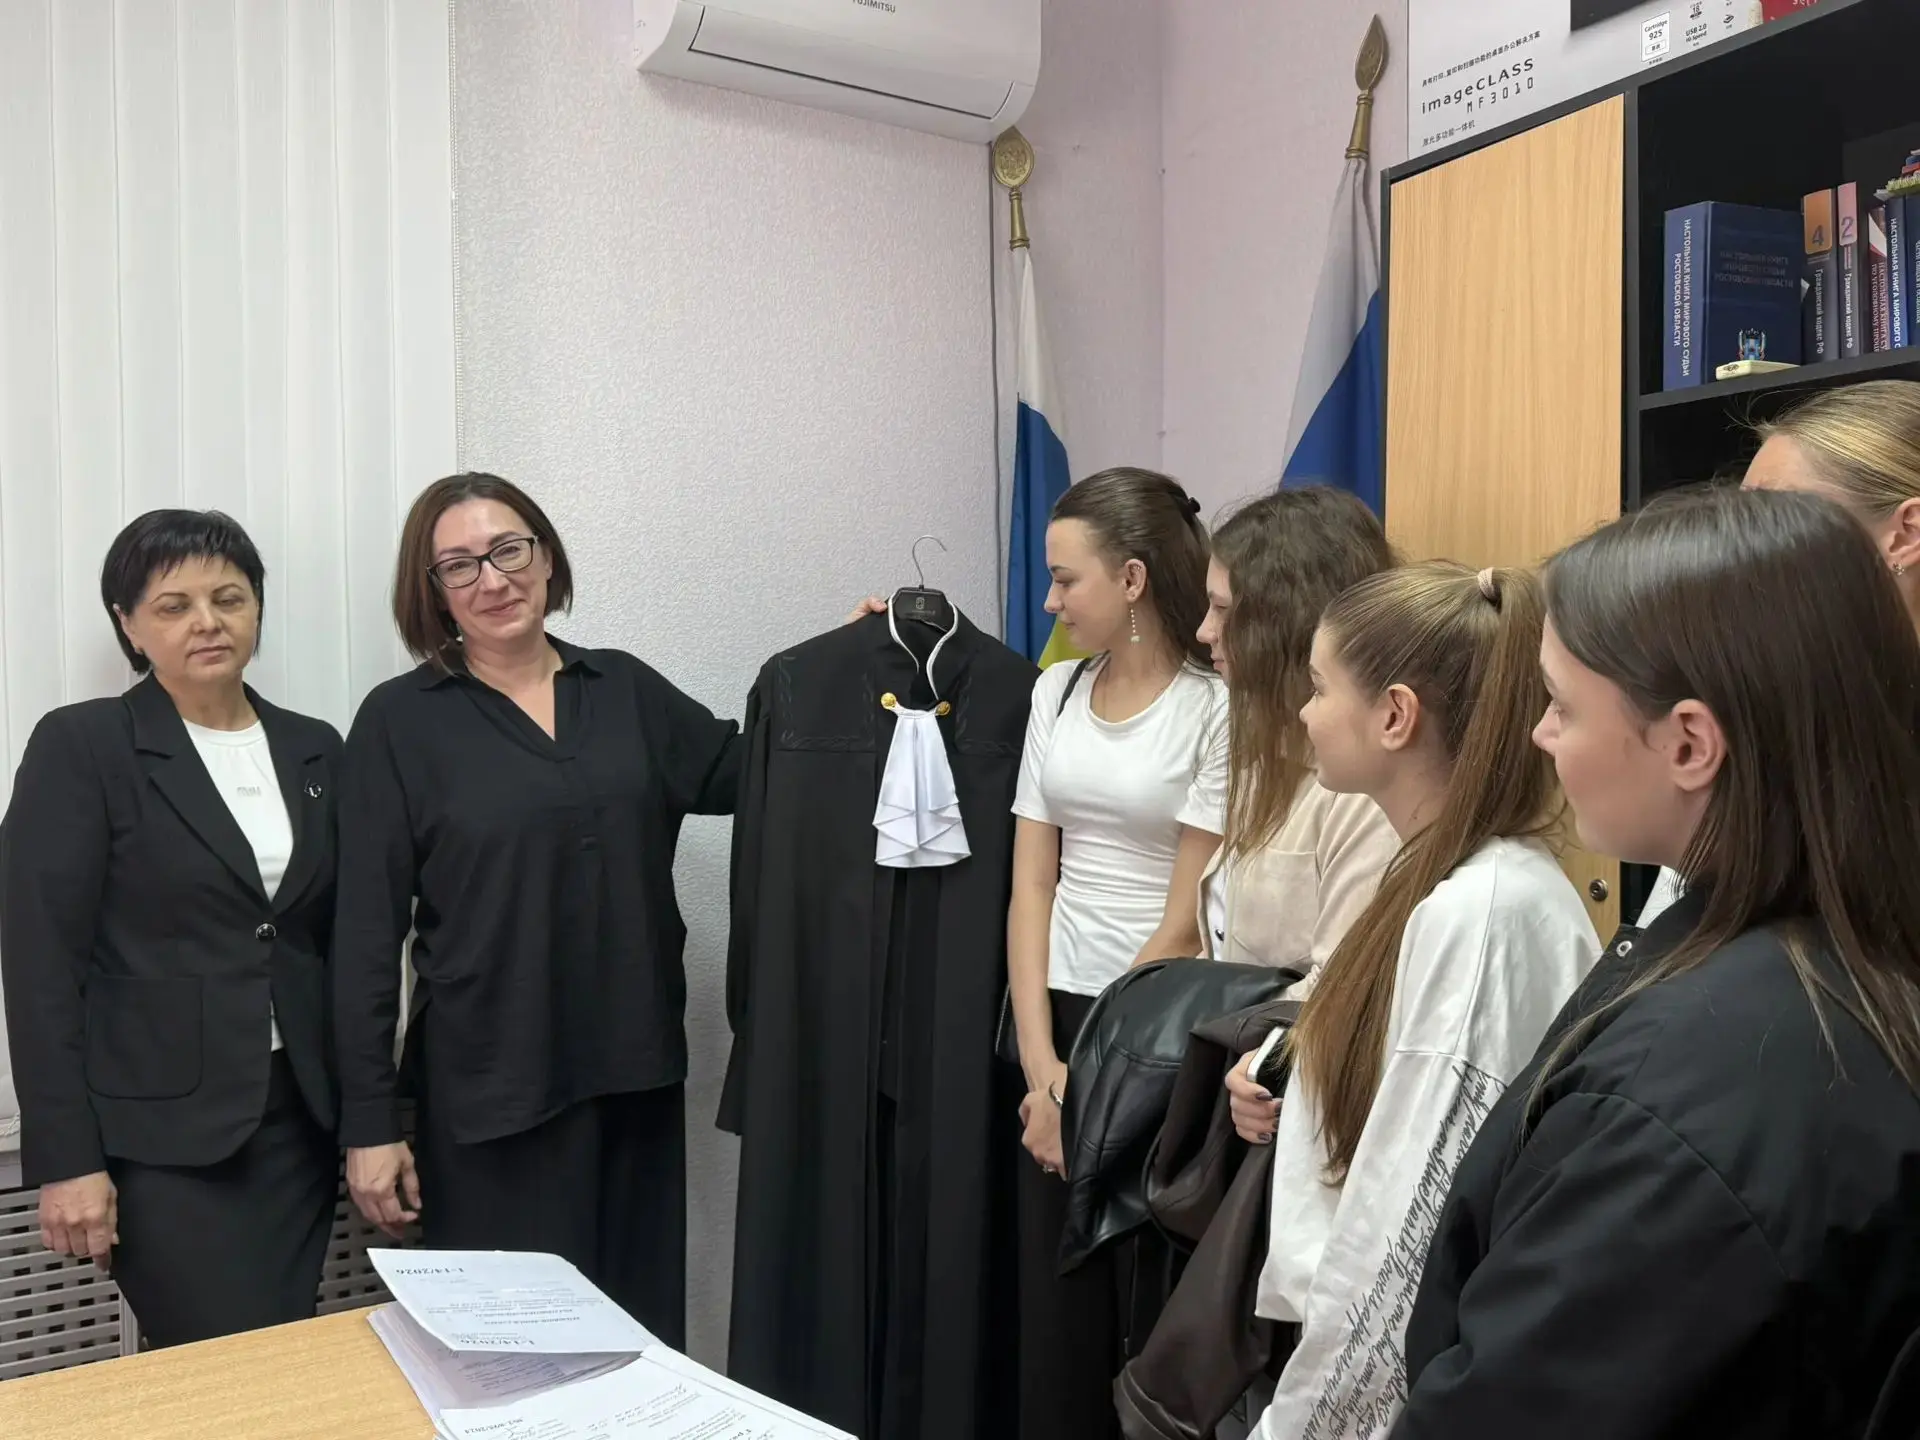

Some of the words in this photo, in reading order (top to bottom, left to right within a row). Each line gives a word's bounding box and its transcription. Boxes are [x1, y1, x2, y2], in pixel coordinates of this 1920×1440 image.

[1644, 19, 1668, 33] Cartridge
[1648, 29, 1662, 41] 925
[1685, 27, 1698, 36] USB
[1698, 23, 1707, 32] 2.0
[1421, 58, 1534, 114] imageCLASS
[1812, 225, 1824, 247] 4
[1841, 216, 1854, 238] 2
[1683, 218, 1692, 274] НАСТОЛЬНАЯ
[1890, 218, 1899, 270] НАСТОЛЬНАЯ
[1674, 253, 1682, 305] РОСТОВСКОЙ
[1683, 274, 1691, 301] КНИГА
[1815, 269, 1824, 315] Гражданский
[1892, 271, 1900, 298] КНИГА
[1844, 273, 1853, 314] Гражданский
[1673, 307, 1681, 347] ОБЛАСТИ
[1682, 302, 1691, 348] МИРОВОГО
[1815, 316, 1824, 341] кодекс
[1844, 316, 1852, 337] кодекс
[1893, 299, 1901, 342] МИРОВОГО
[1816, 342, 1824, 354] РФ
[1845, 337, 1853, 349] РФ
[1682, 349, 1690, 377] СУДЬИ
